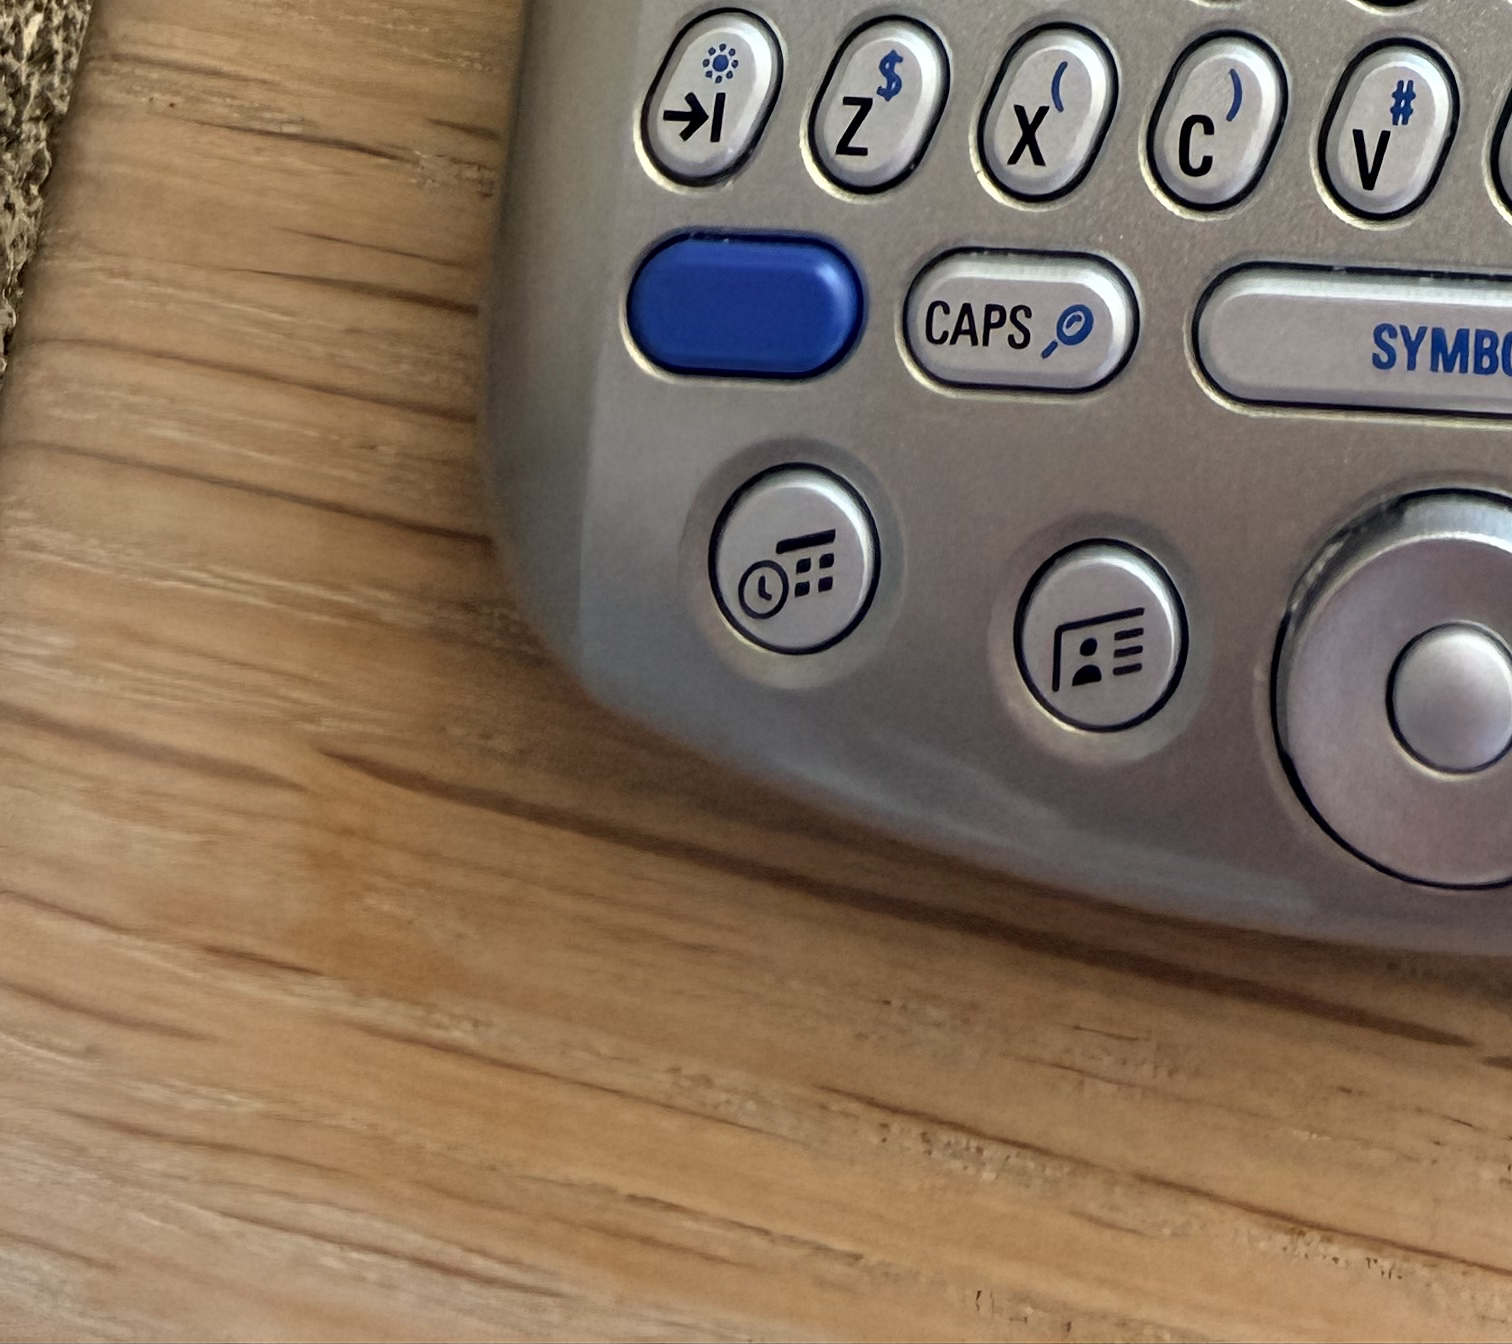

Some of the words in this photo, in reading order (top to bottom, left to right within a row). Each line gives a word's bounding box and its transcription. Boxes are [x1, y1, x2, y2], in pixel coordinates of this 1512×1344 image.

[877, 51, 902, 100] $
[1391, 80, 1416, 125] #
[835, 97, 873, 156] Z
[1007, 105, 1049, 166] X
[1179, 115, 1214, 177] C
[1353, 129, 1390, 190] V
[925, 300, 1032, 349] CAPS
